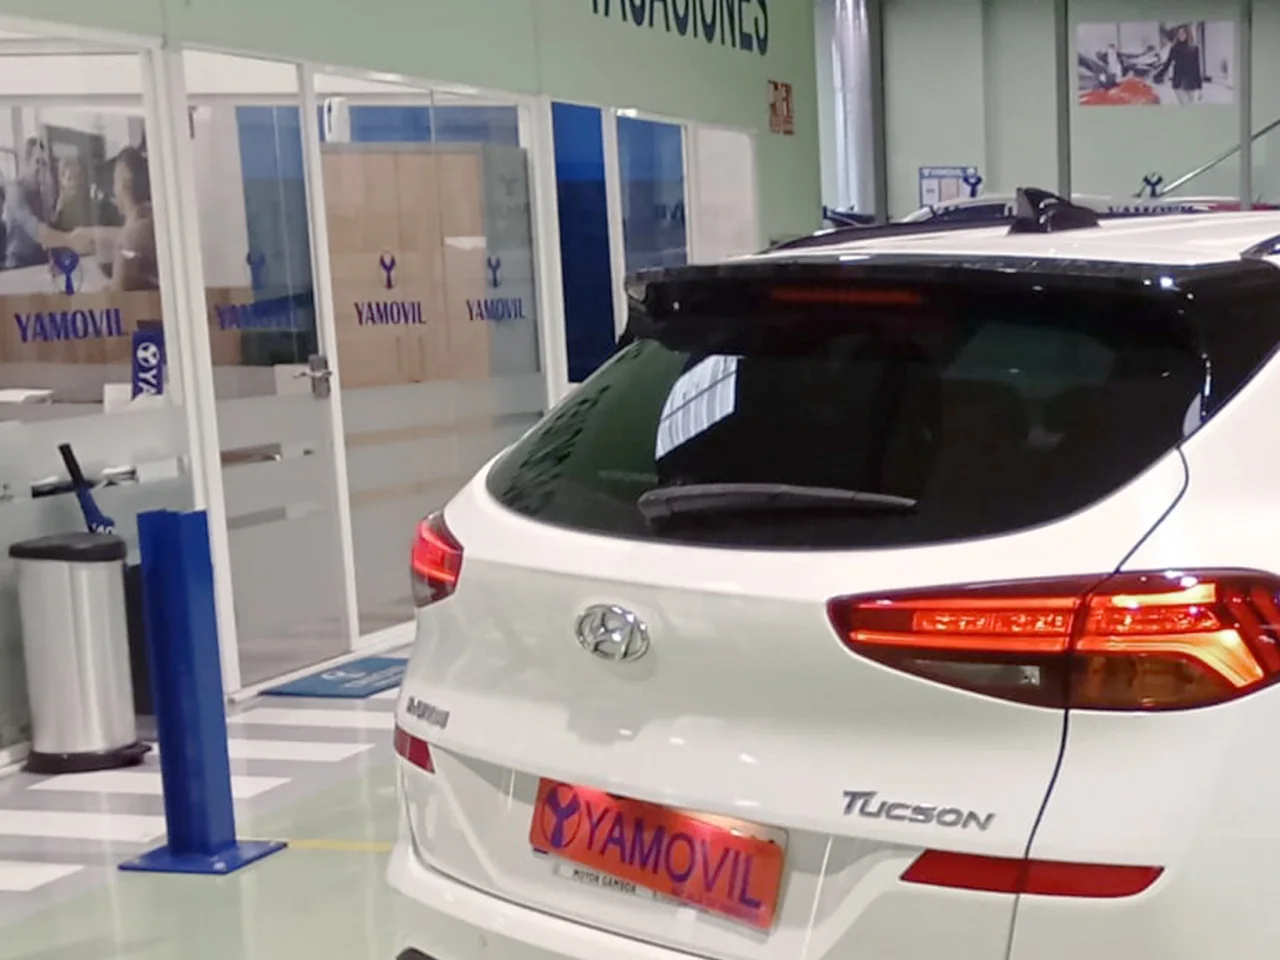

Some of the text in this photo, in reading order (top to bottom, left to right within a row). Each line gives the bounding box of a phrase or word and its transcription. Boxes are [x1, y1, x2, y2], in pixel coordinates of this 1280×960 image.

[354, 301, 427, 326] YAMOVIL
[466, 297, 526, 321] YAMOVIL
[14, 308, 129, 343] YAMOVIL
[584, 800, 763, 910] YAMOVIL
